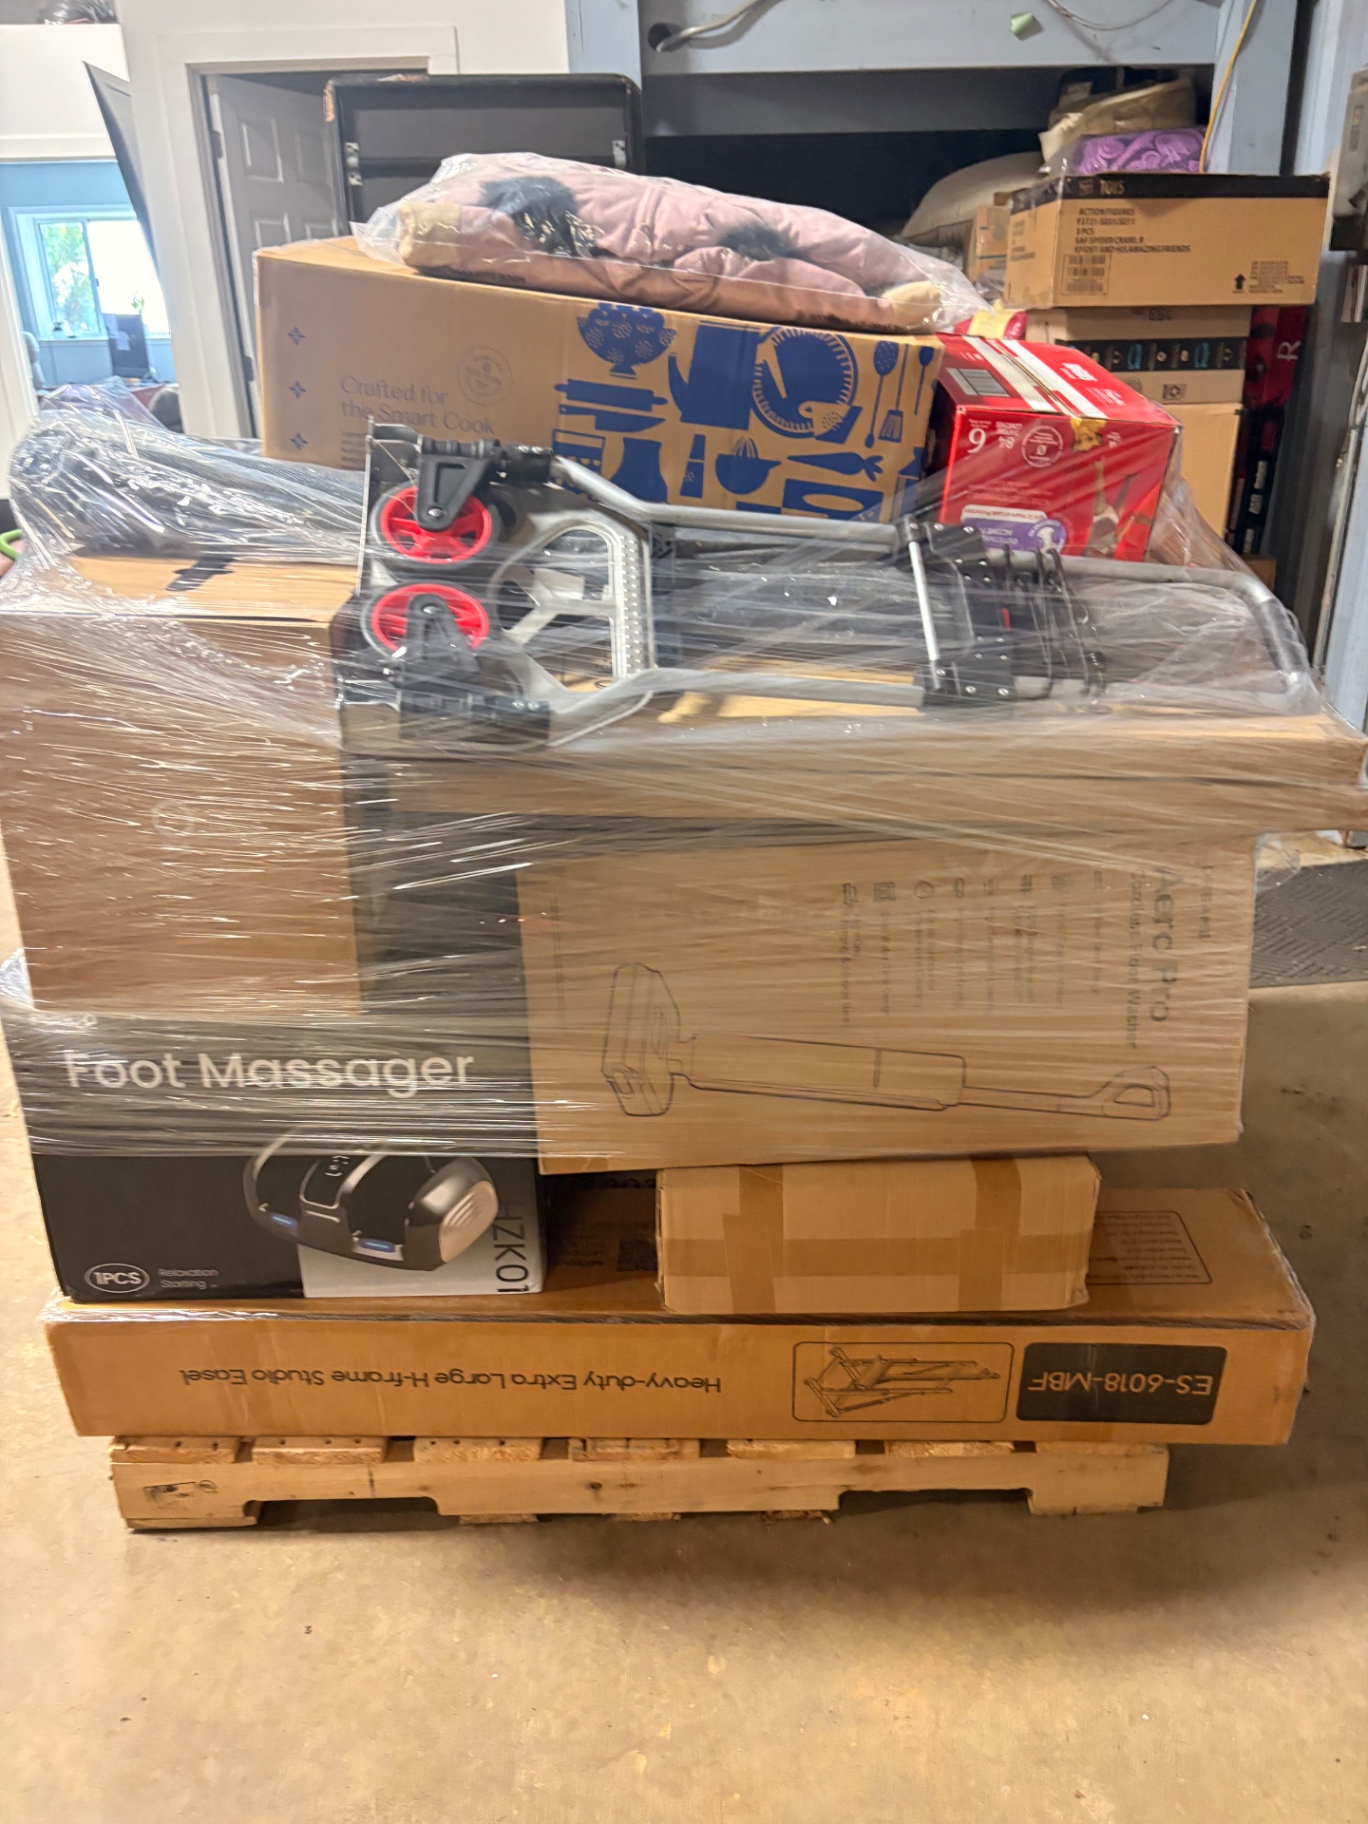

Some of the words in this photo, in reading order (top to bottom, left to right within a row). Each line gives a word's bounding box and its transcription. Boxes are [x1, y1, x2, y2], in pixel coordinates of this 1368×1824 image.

[340, 374, 415, 402] Crafted
[421, 385, 449, 406] for
[341, 398, 373, 421] the
[379, 402, 437, 428] Smart
[444, 411, 496, 435] Cook
[63, 1051, 186, 1089] Foot
[199, 1051, 475, 1098] Massager
[93, 1272, 142, 1285] 1PCS
[181, 1367, 246, 1385] Easel
[252, 1369, 325, 1387] Studio
[332, 1369, 429, 1388] H-frame
[435, 1370, 507, 1390] Large
[513, 1374, 578, 1391] Extra
[584, 1371, 721, 1393] Heavy-duty
[1027, 1371, 1214, 1395] ES-6018-MBF
